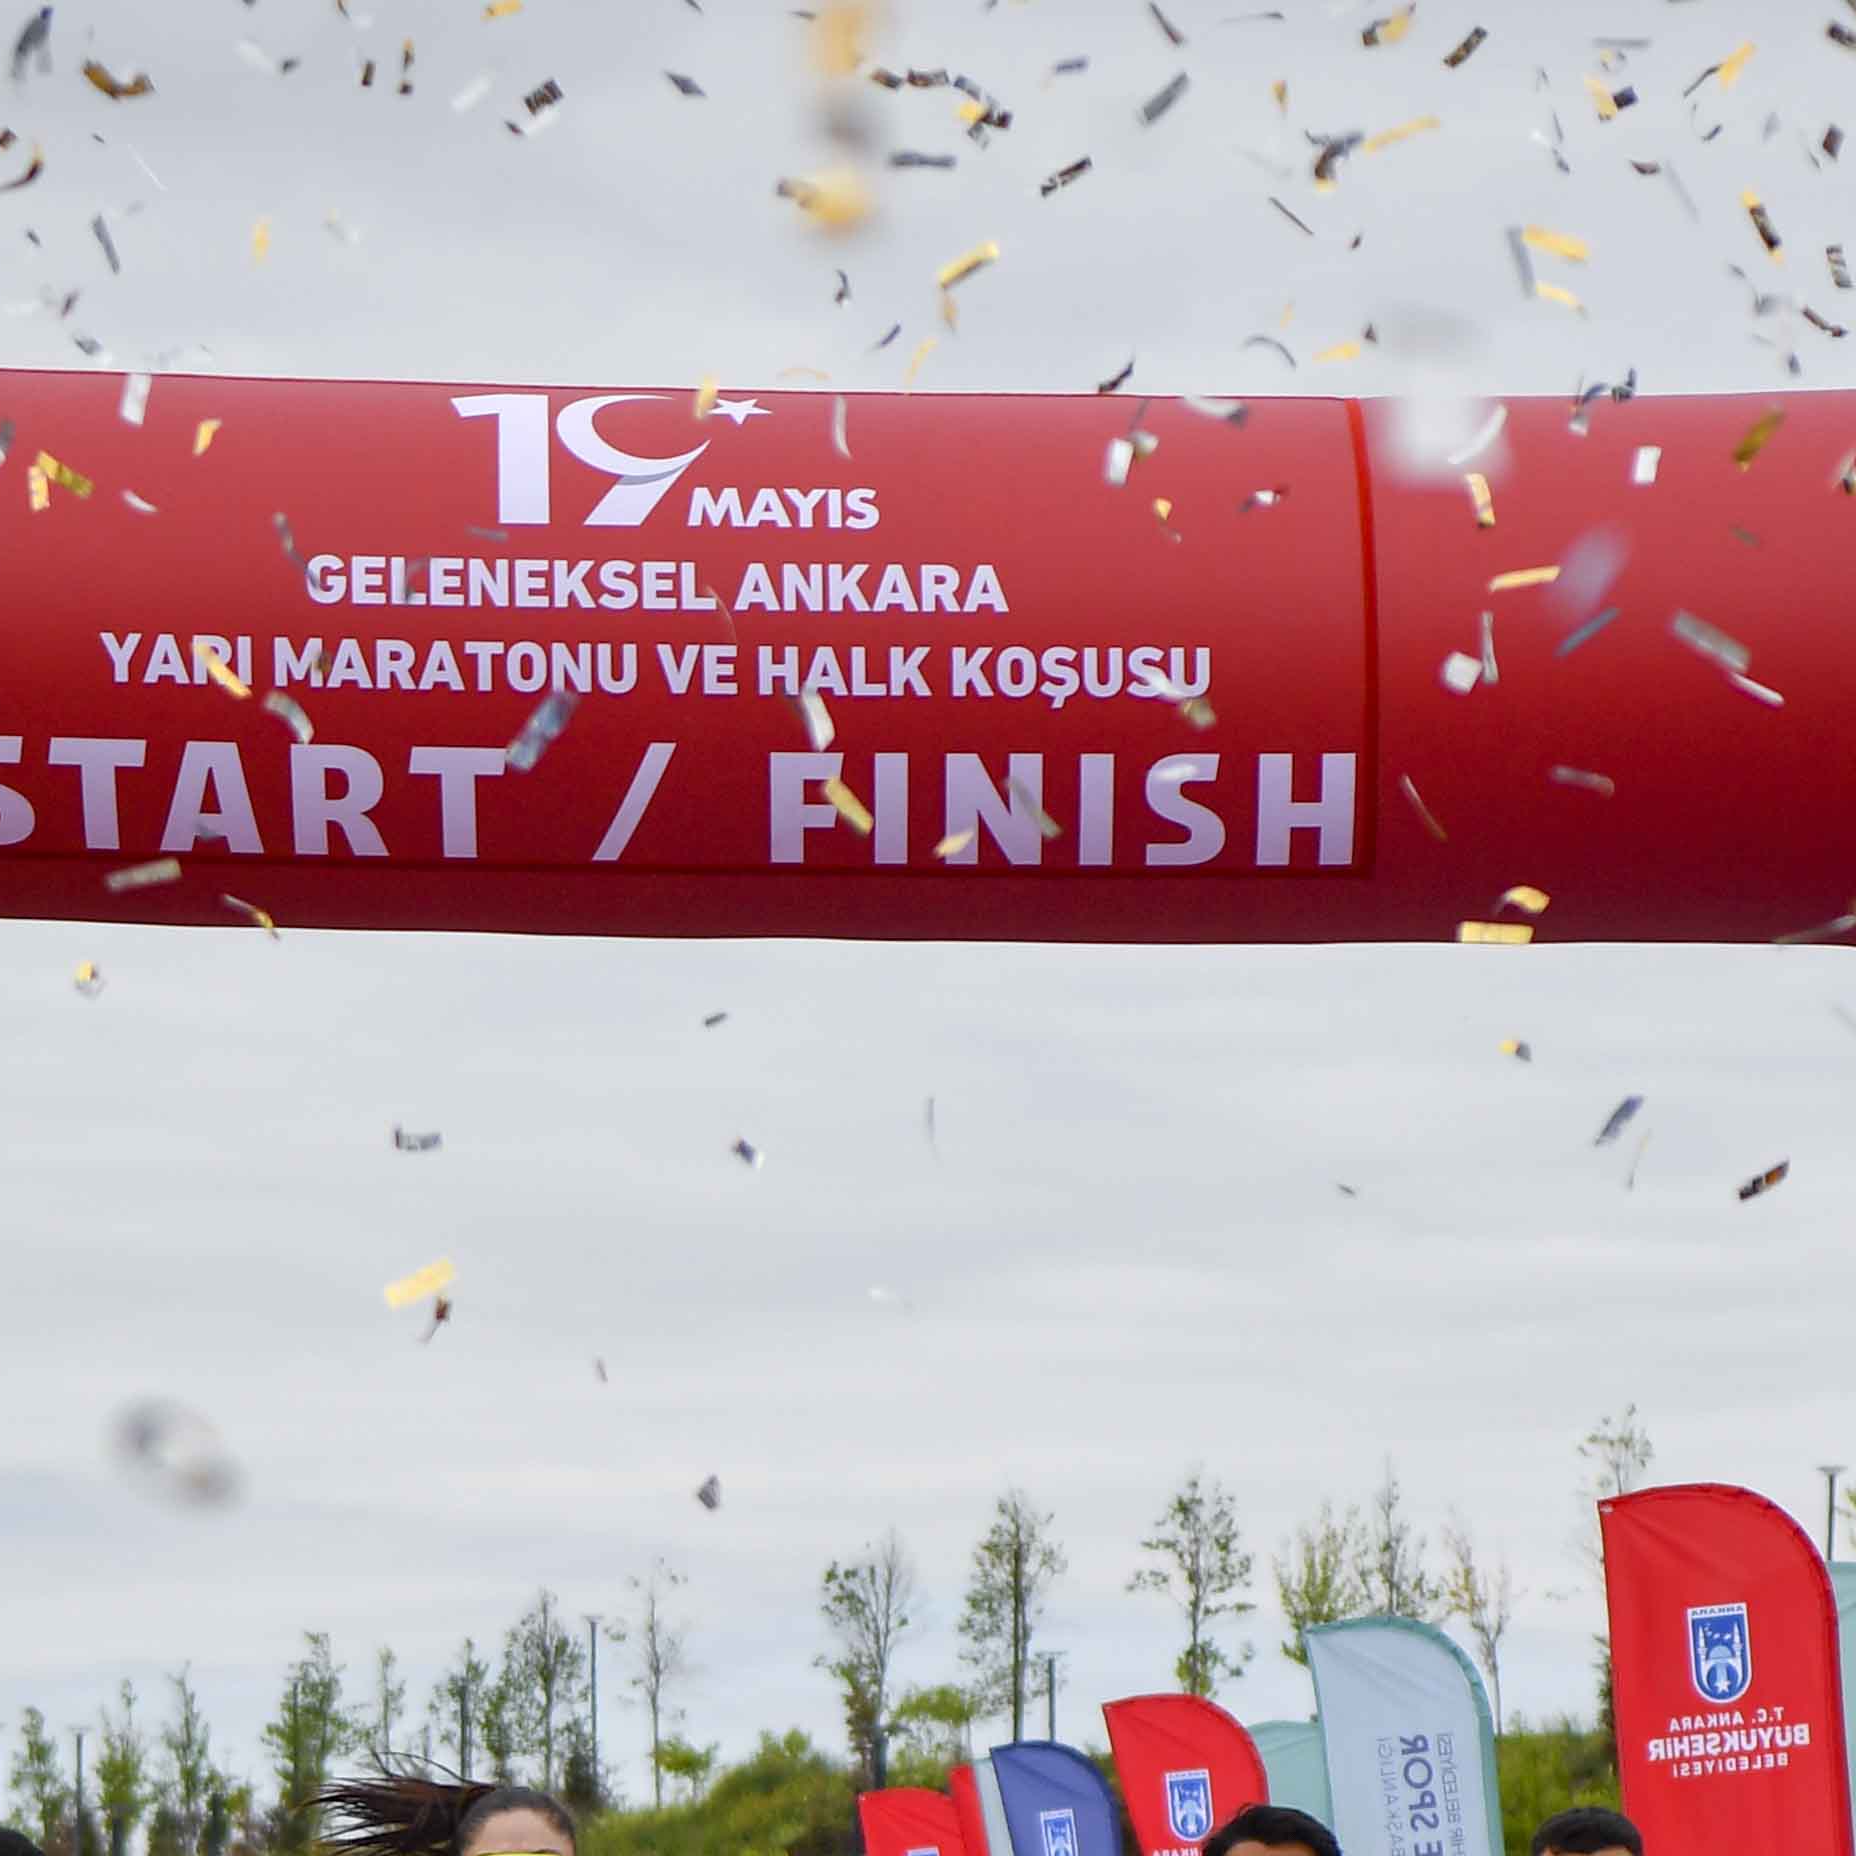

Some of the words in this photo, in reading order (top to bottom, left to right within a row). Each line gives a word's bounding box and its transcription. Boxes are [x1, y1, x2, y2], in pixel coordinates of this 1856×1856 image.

[451, 393, 710, 528] 19
[688, 486, 881, 531] MAYIS
[305, 554, 717, 612] GELENEKSEL
[735, 560, 1010, 616] ANKARA
[100, 630, 252, 688] YARI
[273, 636, 640, 696] MARATONU
[658, 641, 740, 696] VE
[759, 643, 932, 700] HALK
[952, 646, 1212, 708] KOŞUSU
[591, 741, 676, 862] /
[770, 750, 1357, 867] FINISH
